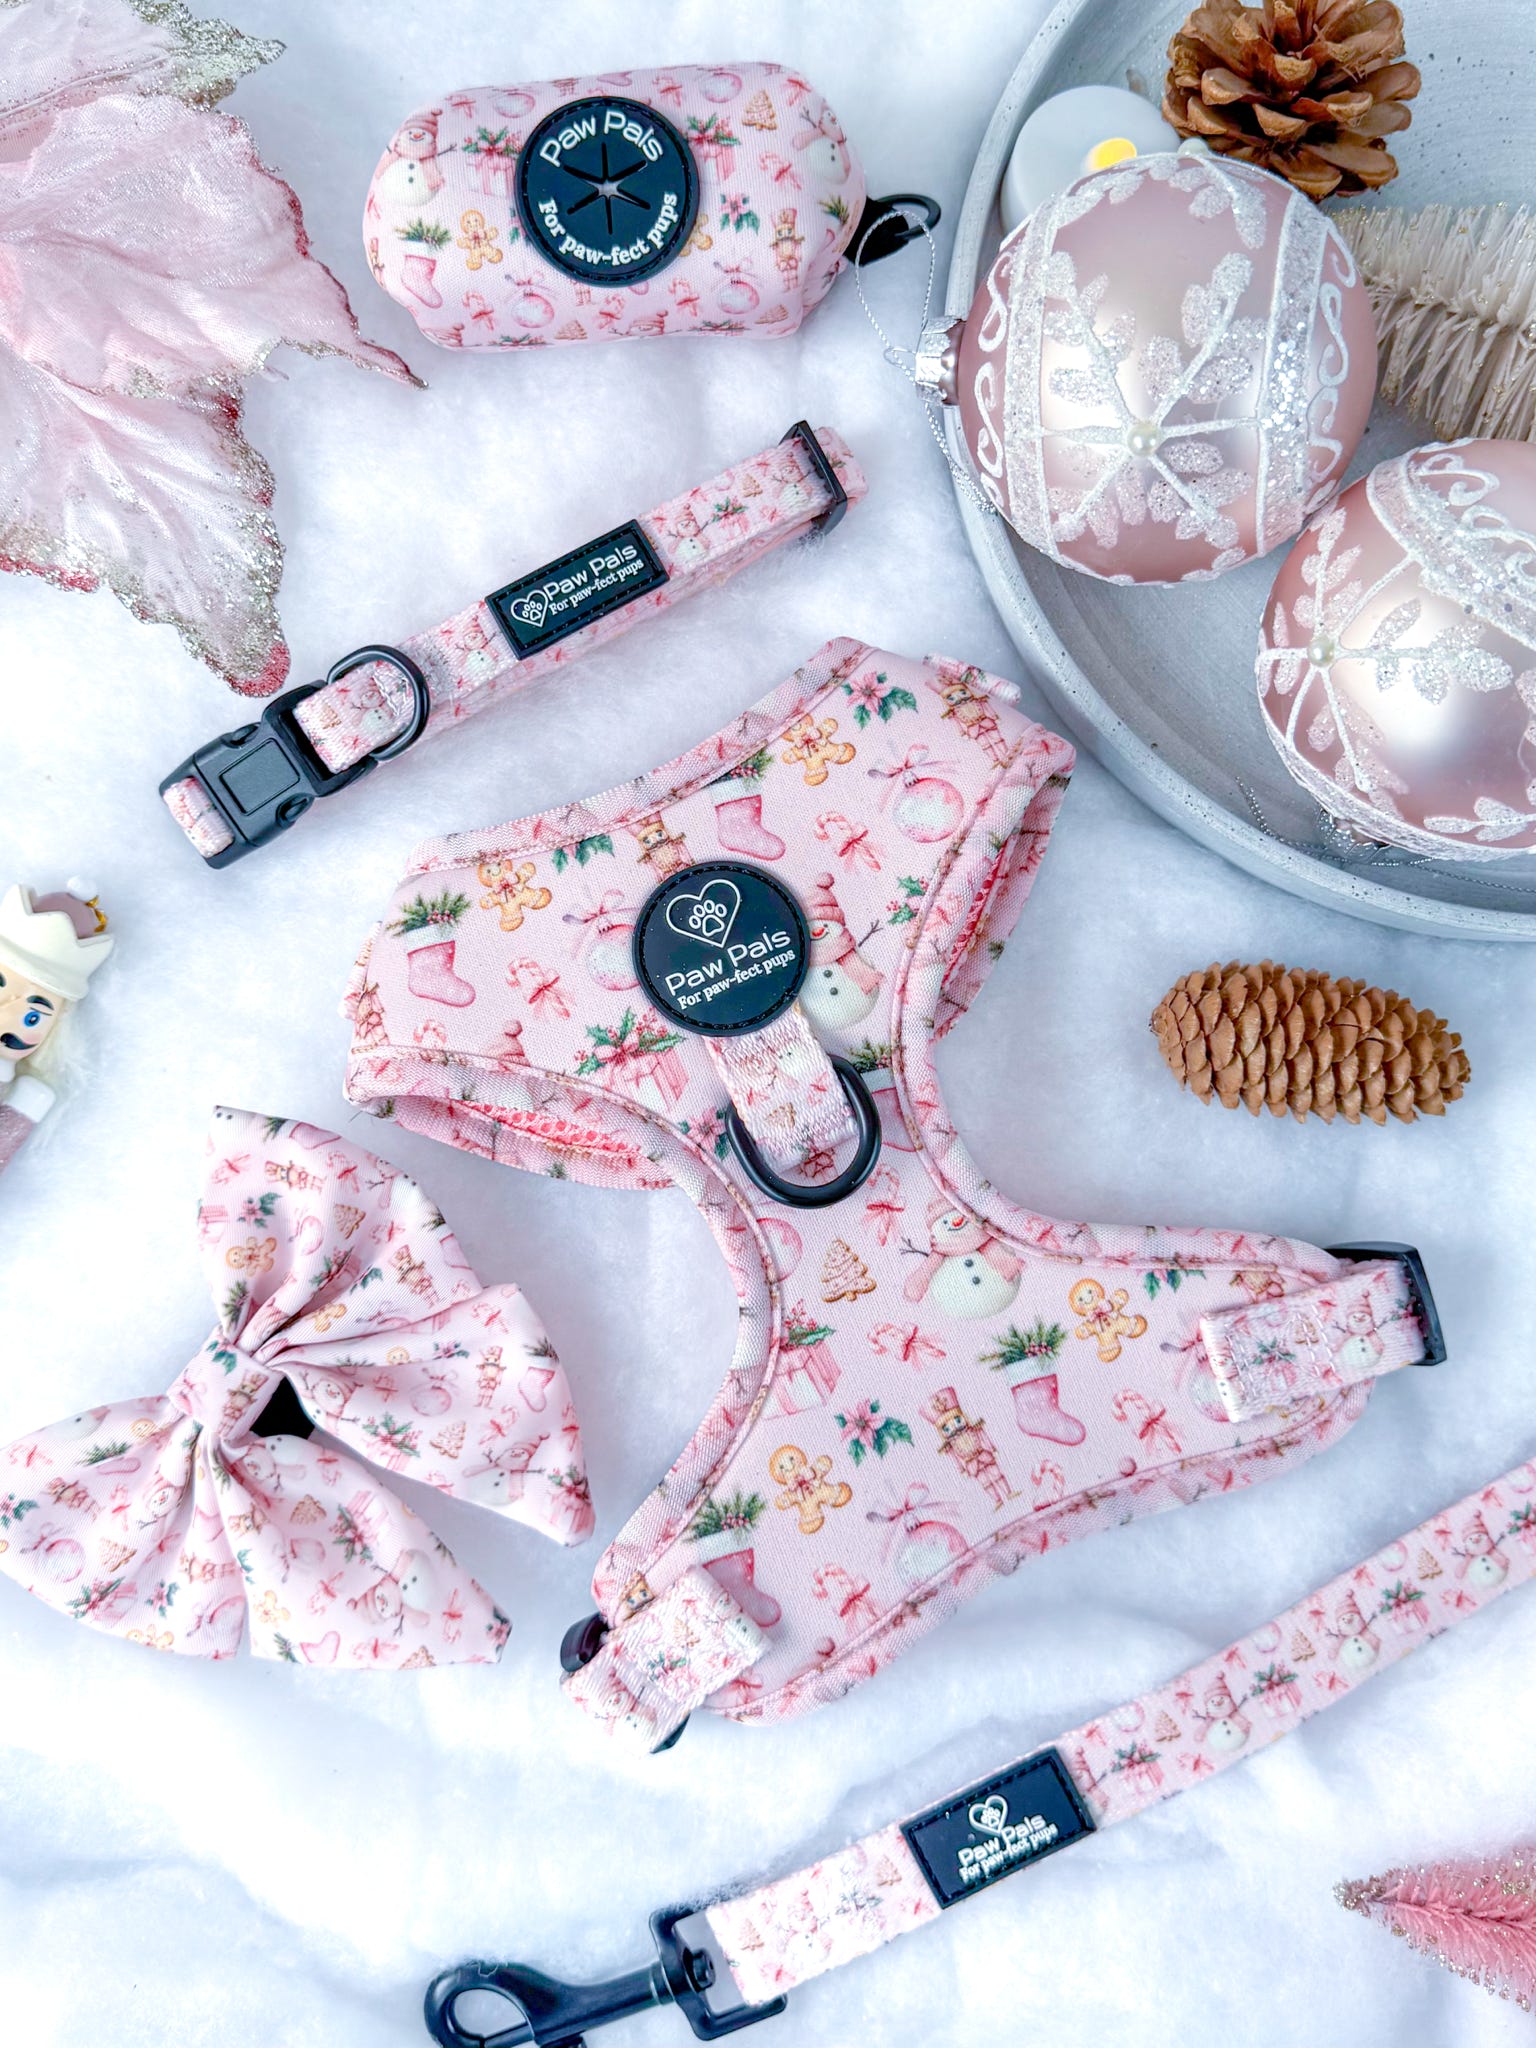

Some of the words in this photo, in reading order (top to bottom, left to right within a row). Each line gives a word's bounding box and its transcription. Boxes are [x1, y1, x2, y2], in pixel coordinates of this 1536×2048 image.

[540, 115, 597, 167] Paw
[604, 109, 663, 162] Pals
[538, 197, 566, 237] For
[559, 234, 651, 266] paw-fect
[647, 191, 678, 249] pups
[544, 570, 588, 601] Paw
[589, 544, 638, 577] Pals
[549, 599, 569, 615] For
[569, 574, 618, 608] paw-fect
[617, 559, 644, 581] pups
[665, 959, 723, 996] Paw
[727, 930, 791, 967] Pals
[677, 992, 702, 1010] For
[702, 964, 763, 1002] paw-fect
[761, 950, 796, 975] pups
[958, 1837, 1000, 1866] Paw
[1001, 1814, 1046, 1849] Pals
[958, 1863, 981, 1883] For
[1030, 1823, 1059, 1850] pups
